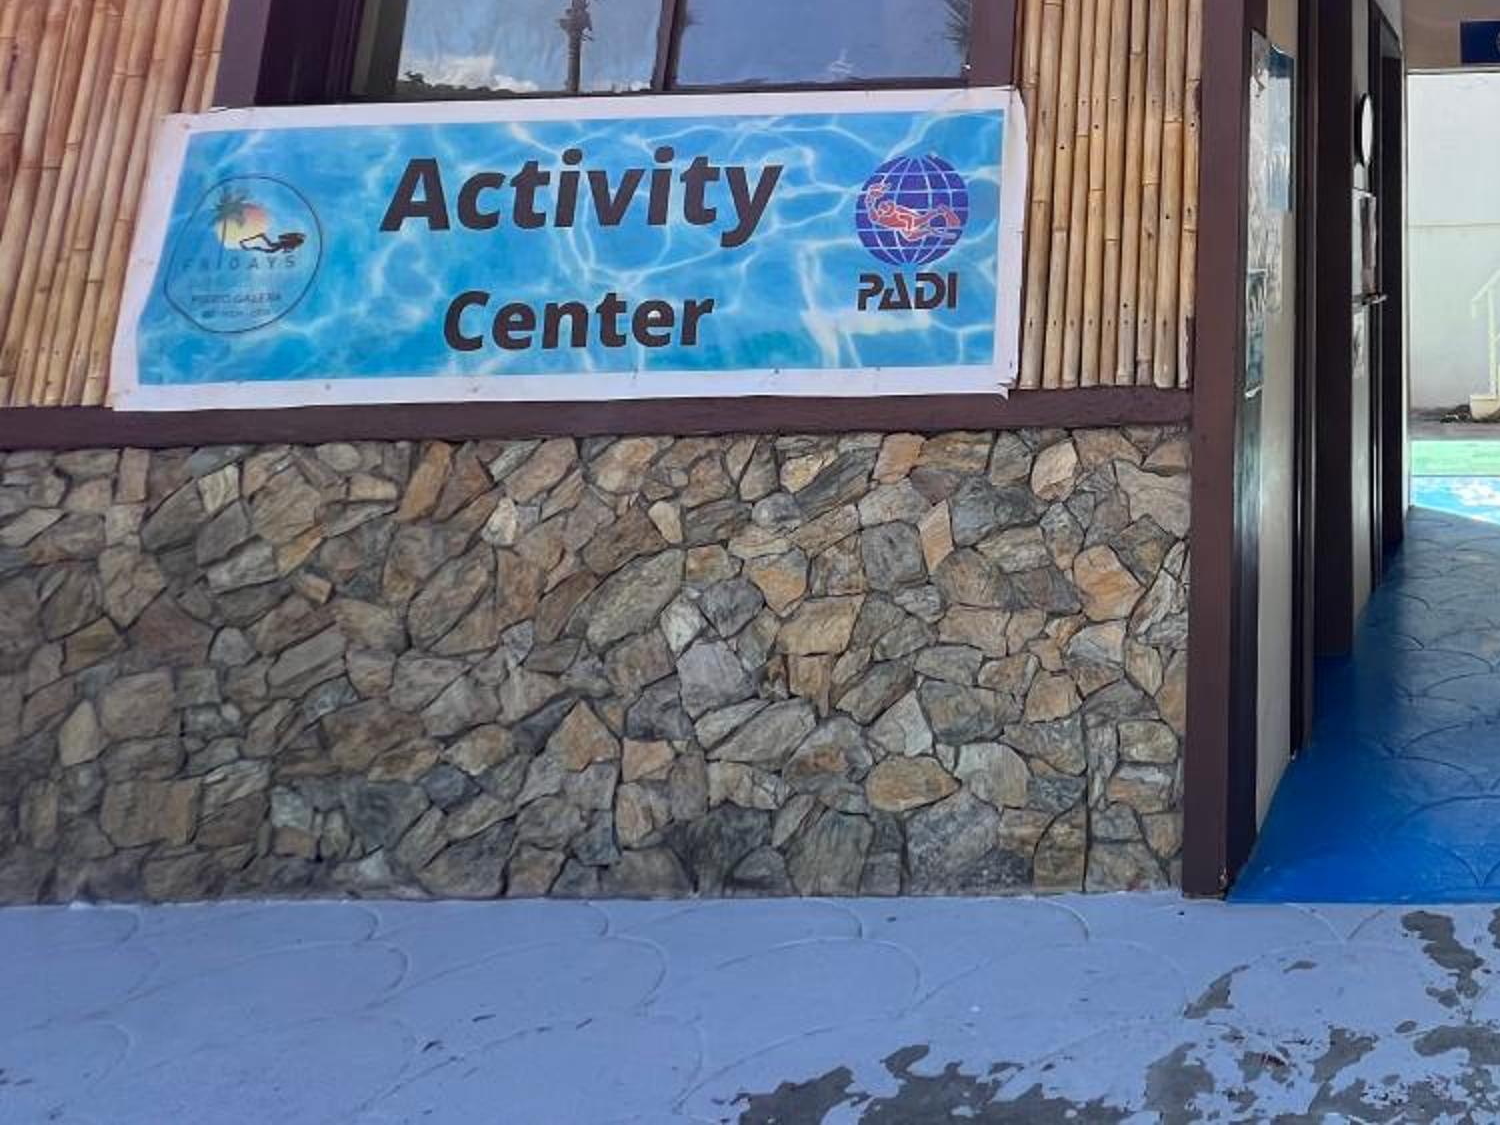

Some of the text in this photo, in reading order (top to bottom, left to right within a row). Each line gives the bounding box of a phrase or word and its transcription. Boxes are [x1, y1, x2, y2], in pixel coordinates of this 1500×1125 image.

[381, 146, 783, 246] Activity
[182, 254, 296, 272] FRIDAYS
[857, 271, 957, 311] PADI
[443, 289, 715, 351] Center
